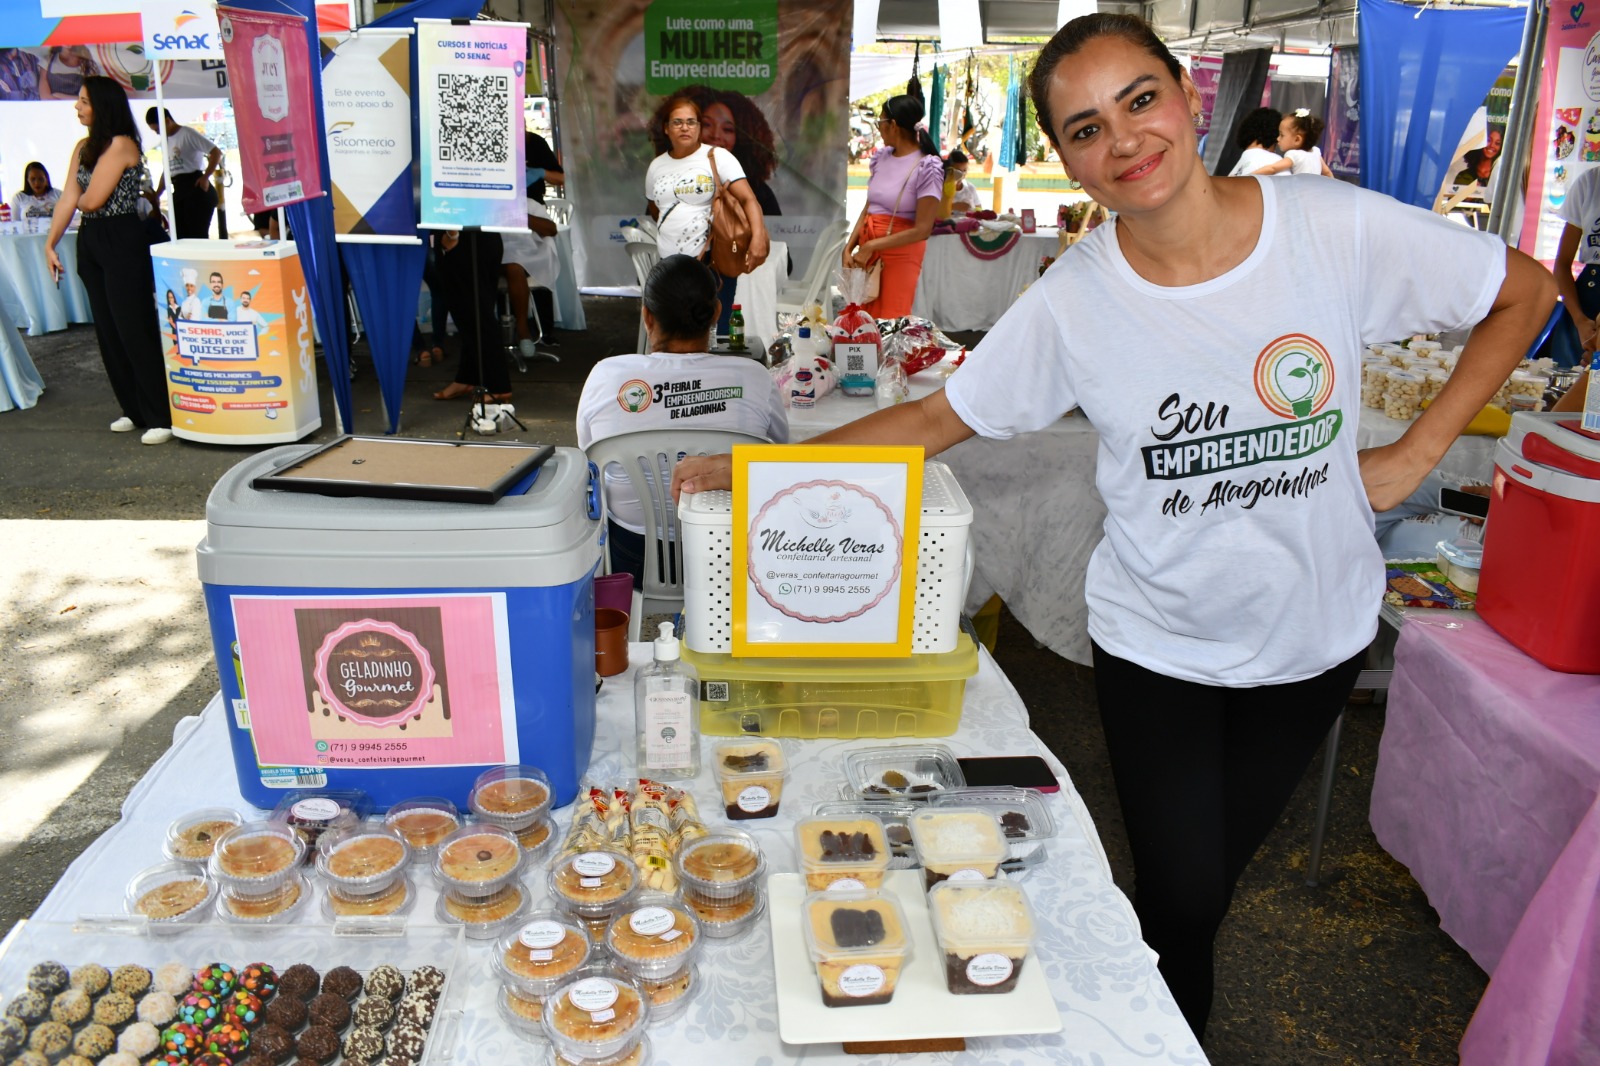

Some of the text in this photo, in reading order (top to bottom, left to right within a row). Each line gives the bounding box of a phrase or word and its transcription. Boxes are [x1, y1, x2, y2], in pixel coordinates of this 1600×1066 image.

[666, 16, 754, 31] Lute como uma
[153, 33, 210, 51] Senac
[437, 40, 508, 50] CURSOS E NOTÍCIAS
[660, 31, 764, 60] MULHER
[455, 52, 491, 61] DO SENAC
[651, 60, 770, 79] Empreendedora
[334, 88, 386, 97] Este evento
[1490, 87, 1512, 97] como
[328, 100, 345, 108] tem
[355, 101, 380, 109] apoio
[381, 100, 394, 108] do
[333, 136, 396, 148] Sicomercio
[187, 326, 225, 337] SENAC,
[226, 328, 249, 337] VOCÊ
[201, 337, 223, 345] SER
[190, 344, 245, 355] QUISER!
[671, 382, 691, 394] FEIRA
[692, 379, 702, 391] DE
[666, 387, 741, 407] EMPREENDEDORISMO
[670, 401, 727, 420] DE ALAGOINHAS
[1151, 392, 1230, 441] Sou
[1151, 415, 1339, 476] EMPREENDEDOR
[1162, 462, 1330, 518] de Alagoinhas
[760, 528, 885, 557] Michelly Veras
[776, 552, 872, 563] confeitaria artesanal
[766, 570, 878, 581] @veras_confeitariagourmet
[793, 584, 871, 594] (71) 9 9945 2555
[340, 661, 412, 679] GELADINHO
[340, 679, 415, 698] Gourmet
[330, 742, 408, 752] (71) 9 9945 2555
[329, 755, 426, 765] @veras_confeitariagourmet
